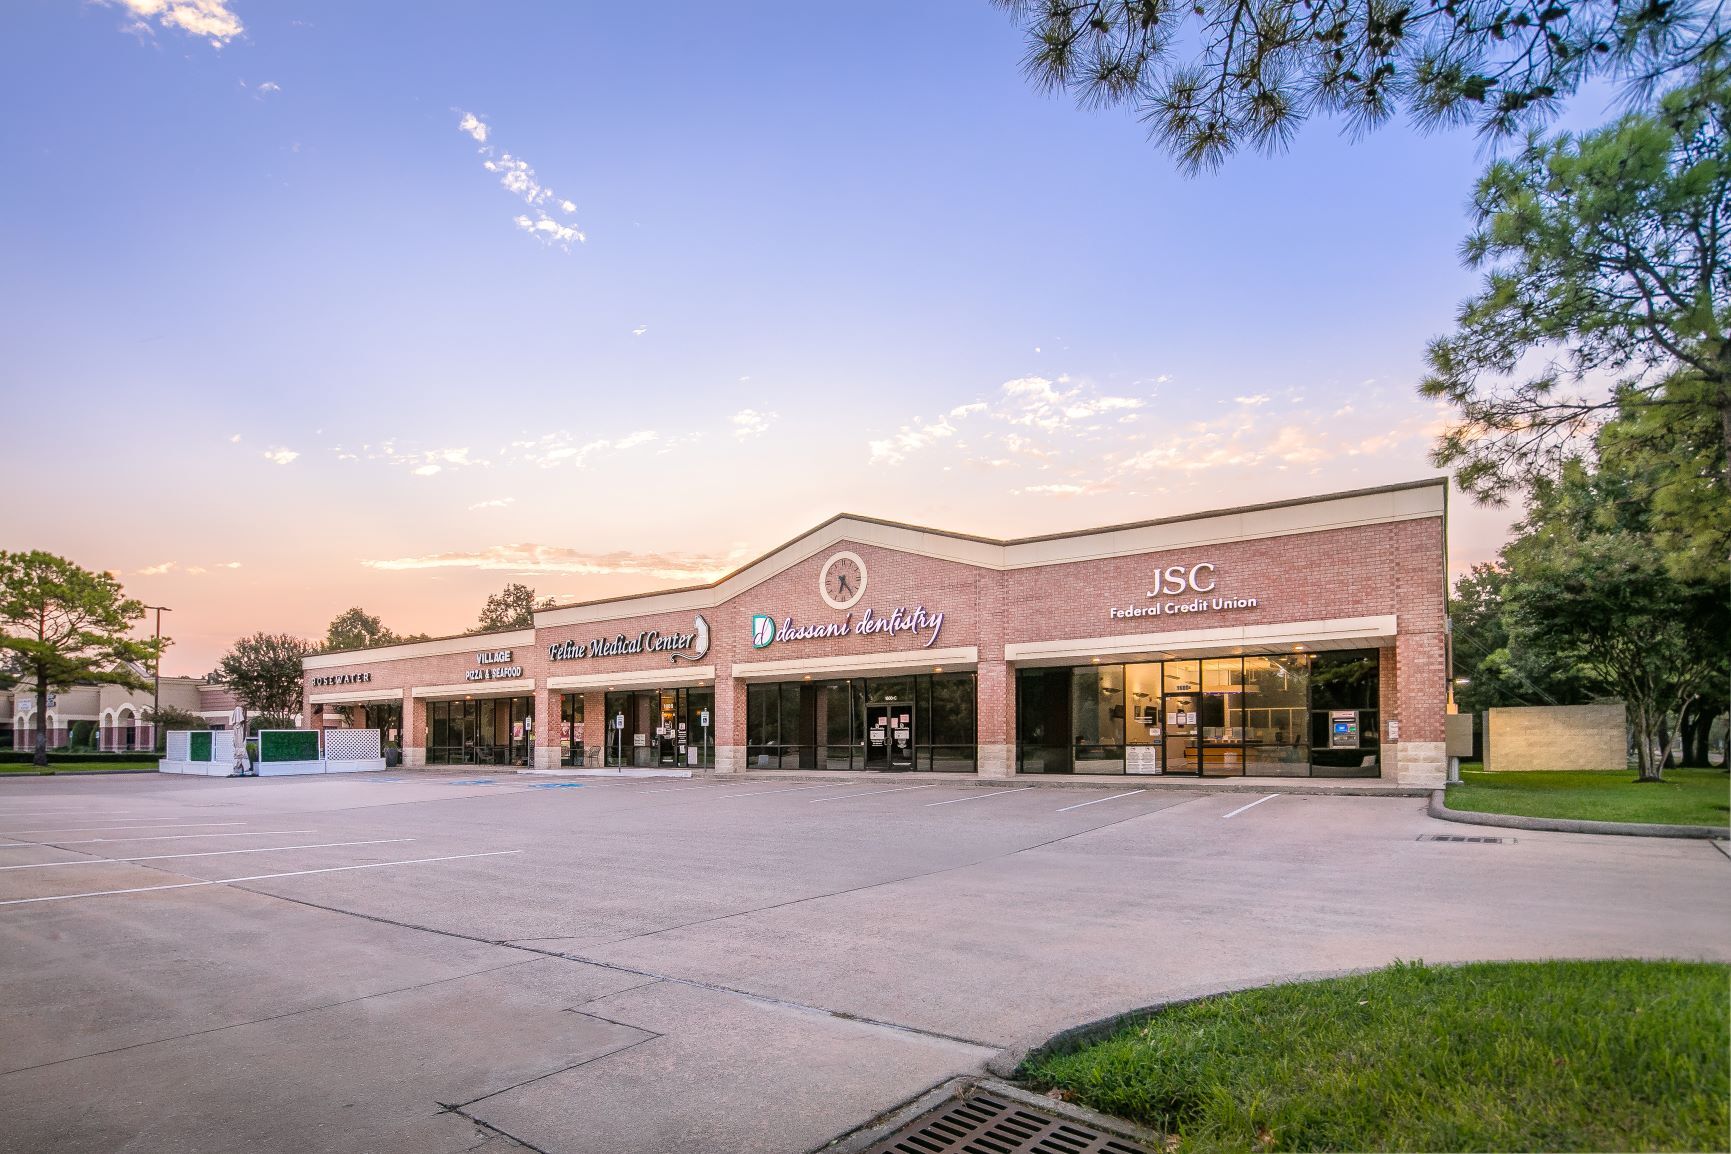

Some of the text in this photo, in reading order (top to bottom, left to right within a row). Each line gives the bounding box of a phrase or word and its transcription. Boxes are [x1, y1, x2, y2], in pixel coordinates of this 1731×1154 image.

[1147, 563, 1216, 597] JSC
[1110, 596, 1258, 619] Federal Credit Union
[776, 612, 852, 643] dassani
[855, 605, 945, 648] dentistry
[476, 650, 514, 664] VILLAGE
[548, 630, 696, 662] Feline Medical Center
[311, 672, 372, 687] ROSEWATER
[465, 666, 524, 681] PIZZA & SEAFOOD
